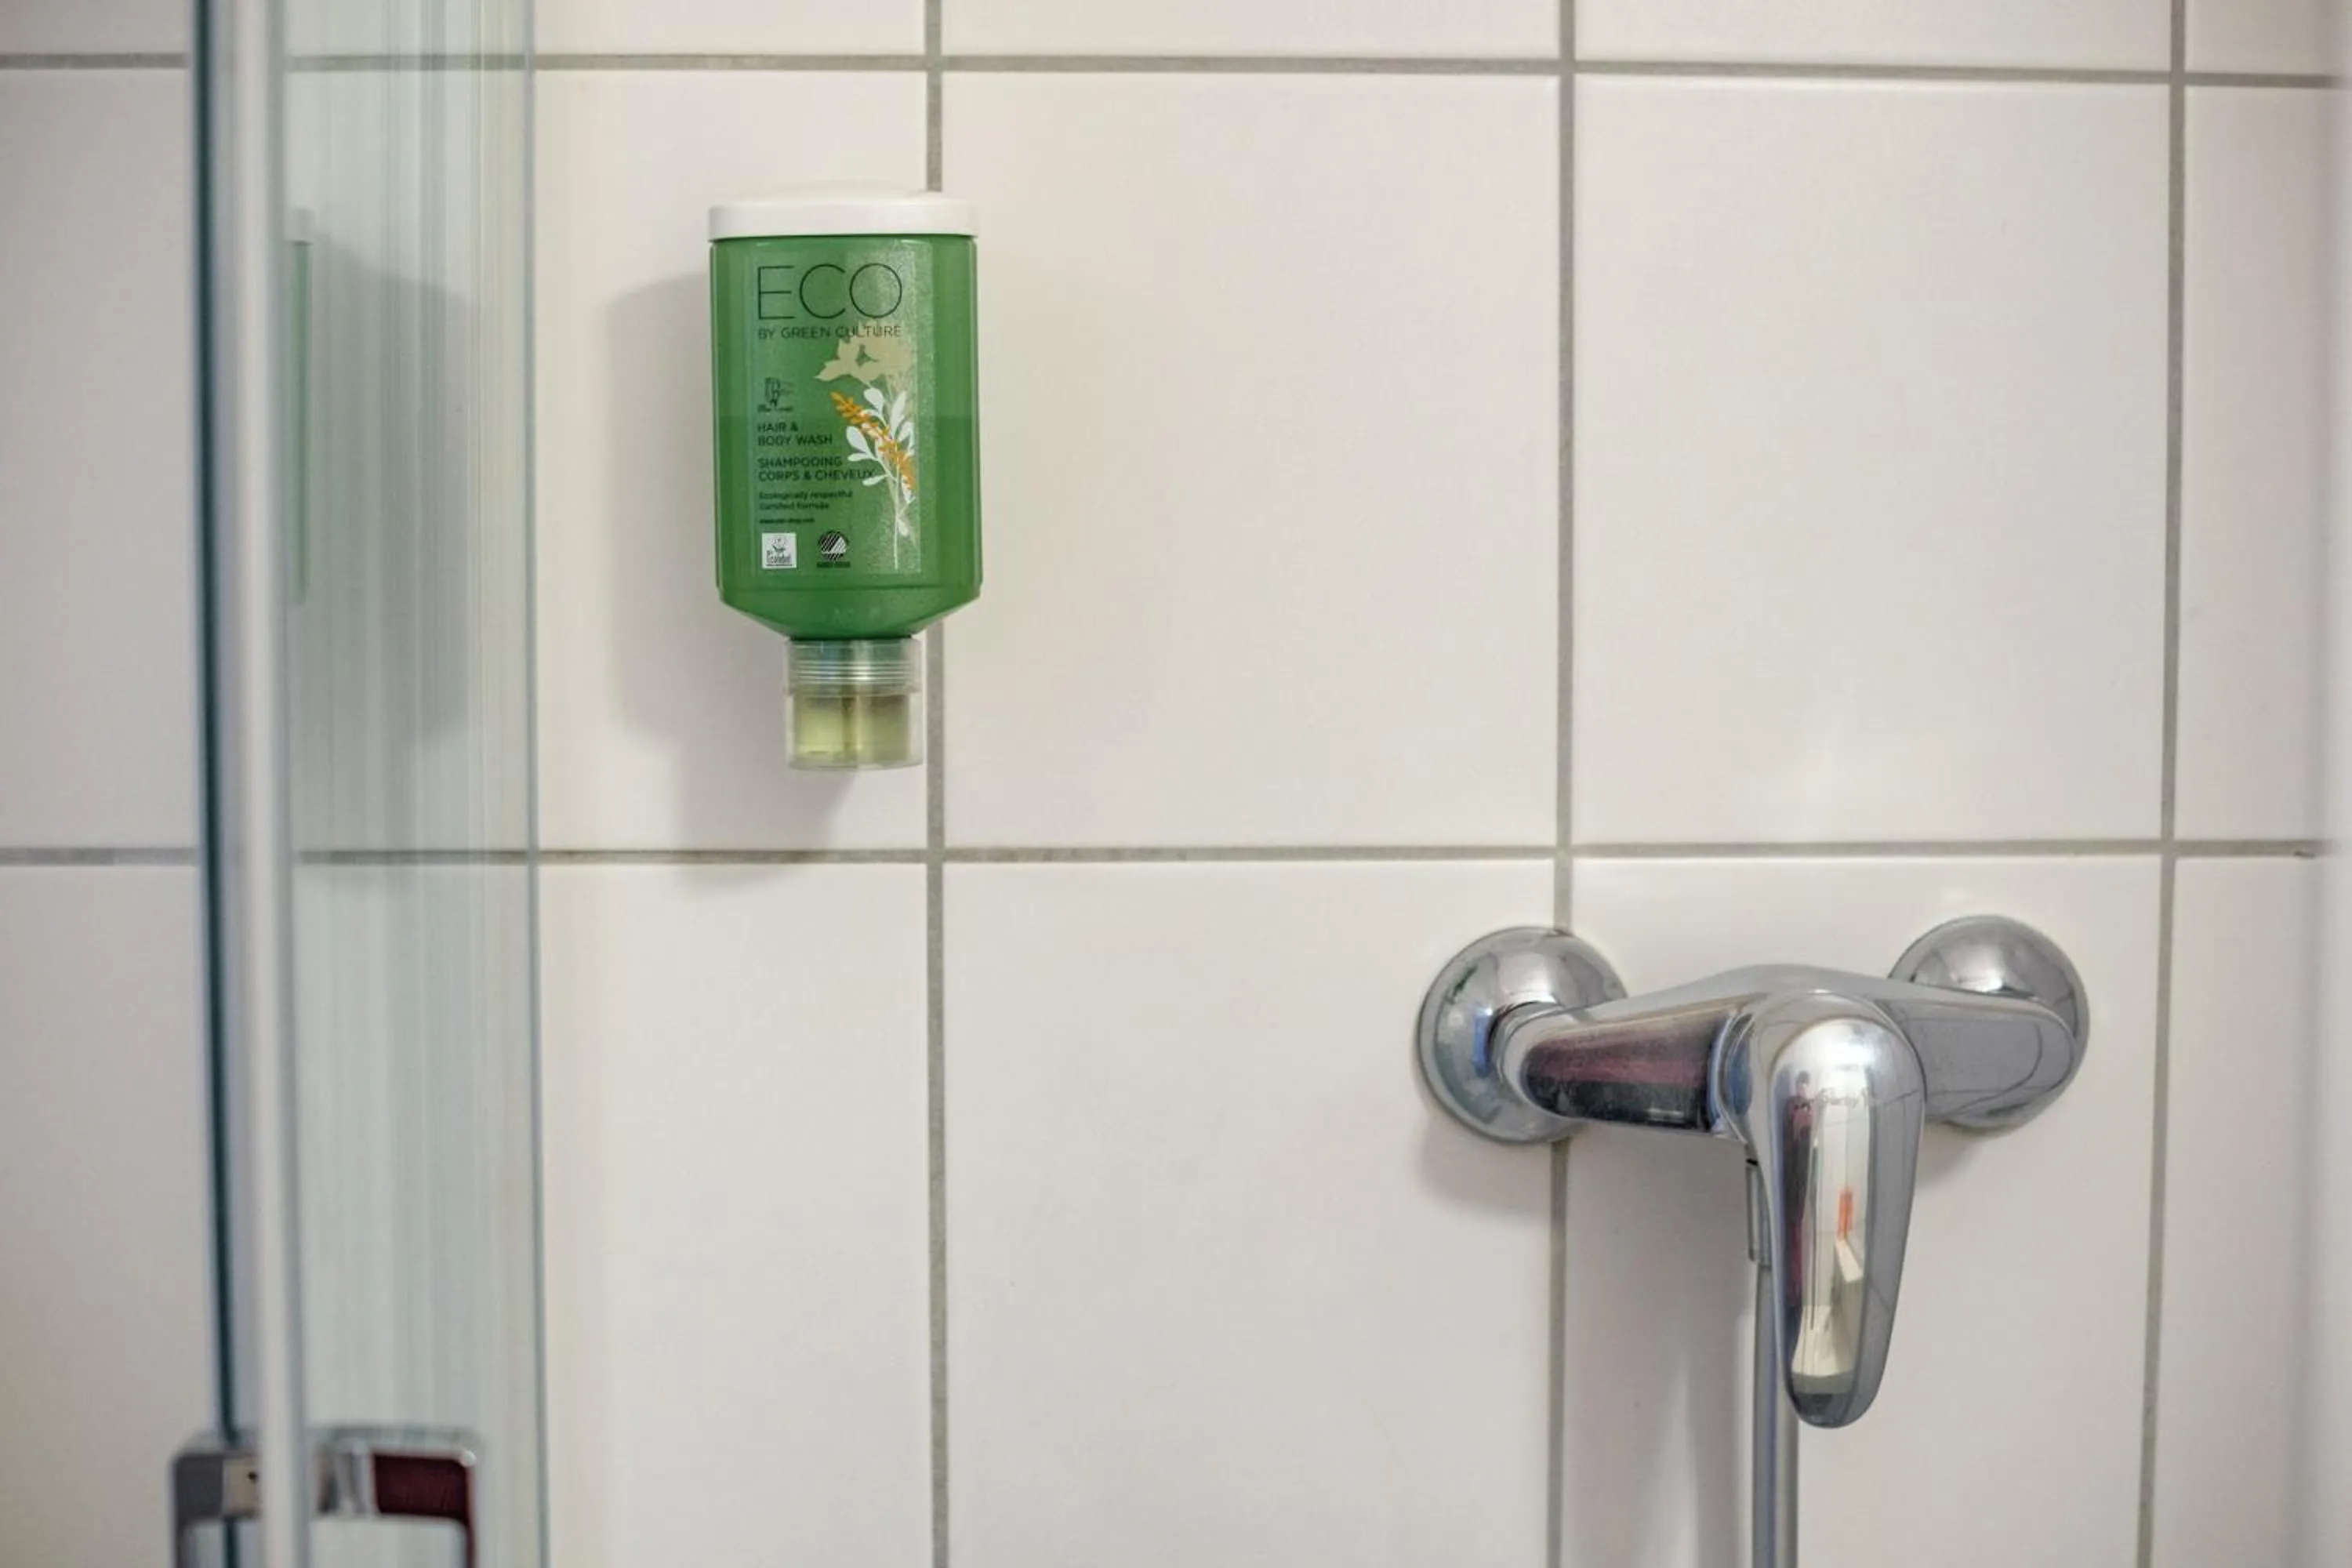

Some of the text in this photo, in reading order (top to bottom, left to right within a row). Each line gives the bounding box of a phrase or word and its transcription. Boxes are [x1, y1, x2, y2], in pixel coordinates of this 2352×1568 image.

[757, 263, 902, 320] ECO
[757, 325, 902, 339] BY GREEN CULTURE
[757, 422, 798, 433] HAIR &
[757, 434, 833, 446] BODY WASH
[757, 456, 844, 468] SHAMPOOING
[758, 469, 875, 482] CORPS & CHEVEUX
